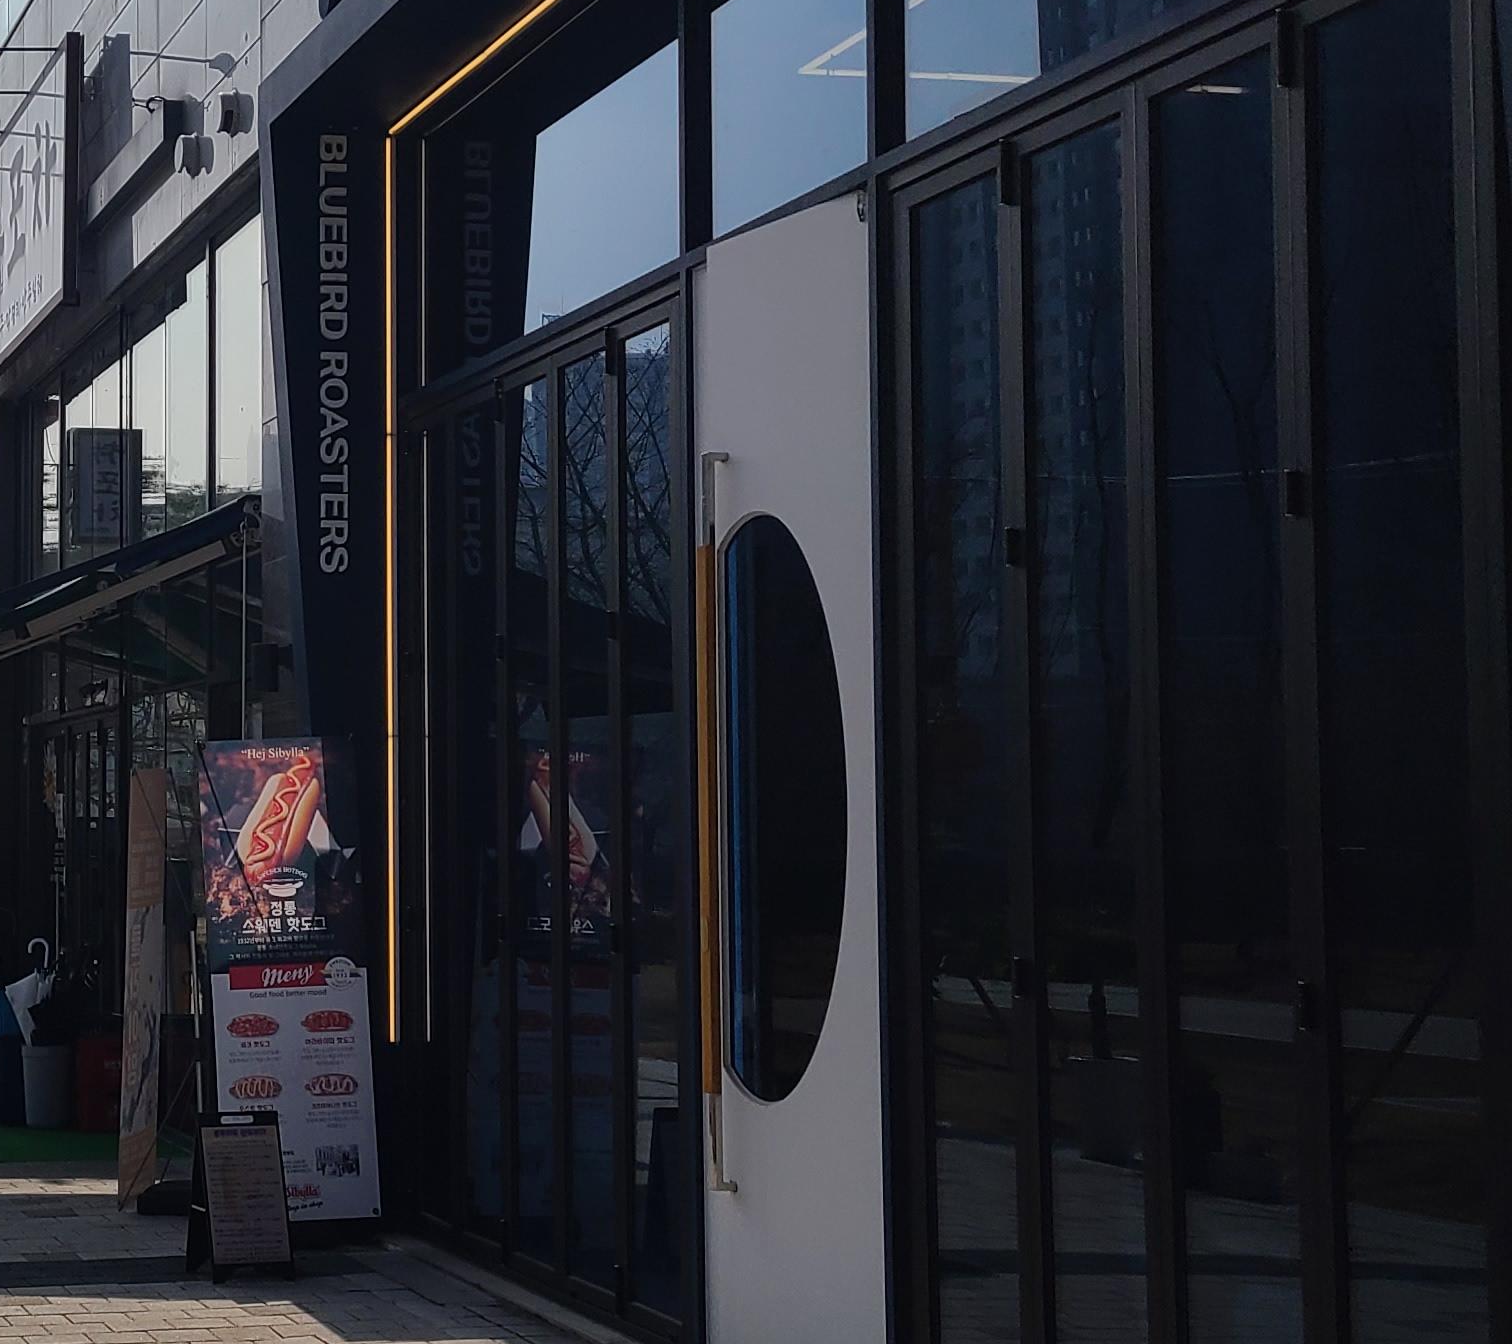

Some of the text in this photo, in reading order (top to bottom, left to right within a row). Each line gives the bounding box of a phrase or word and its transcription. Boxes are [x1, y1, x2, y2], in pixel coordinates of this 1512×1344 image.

[319, 133, 349, 573] BLUEBIRD ROASTERS
[270, 901, 297, 917] 정통
[242, 916, 328, 935] 스웨덴 핫도그
